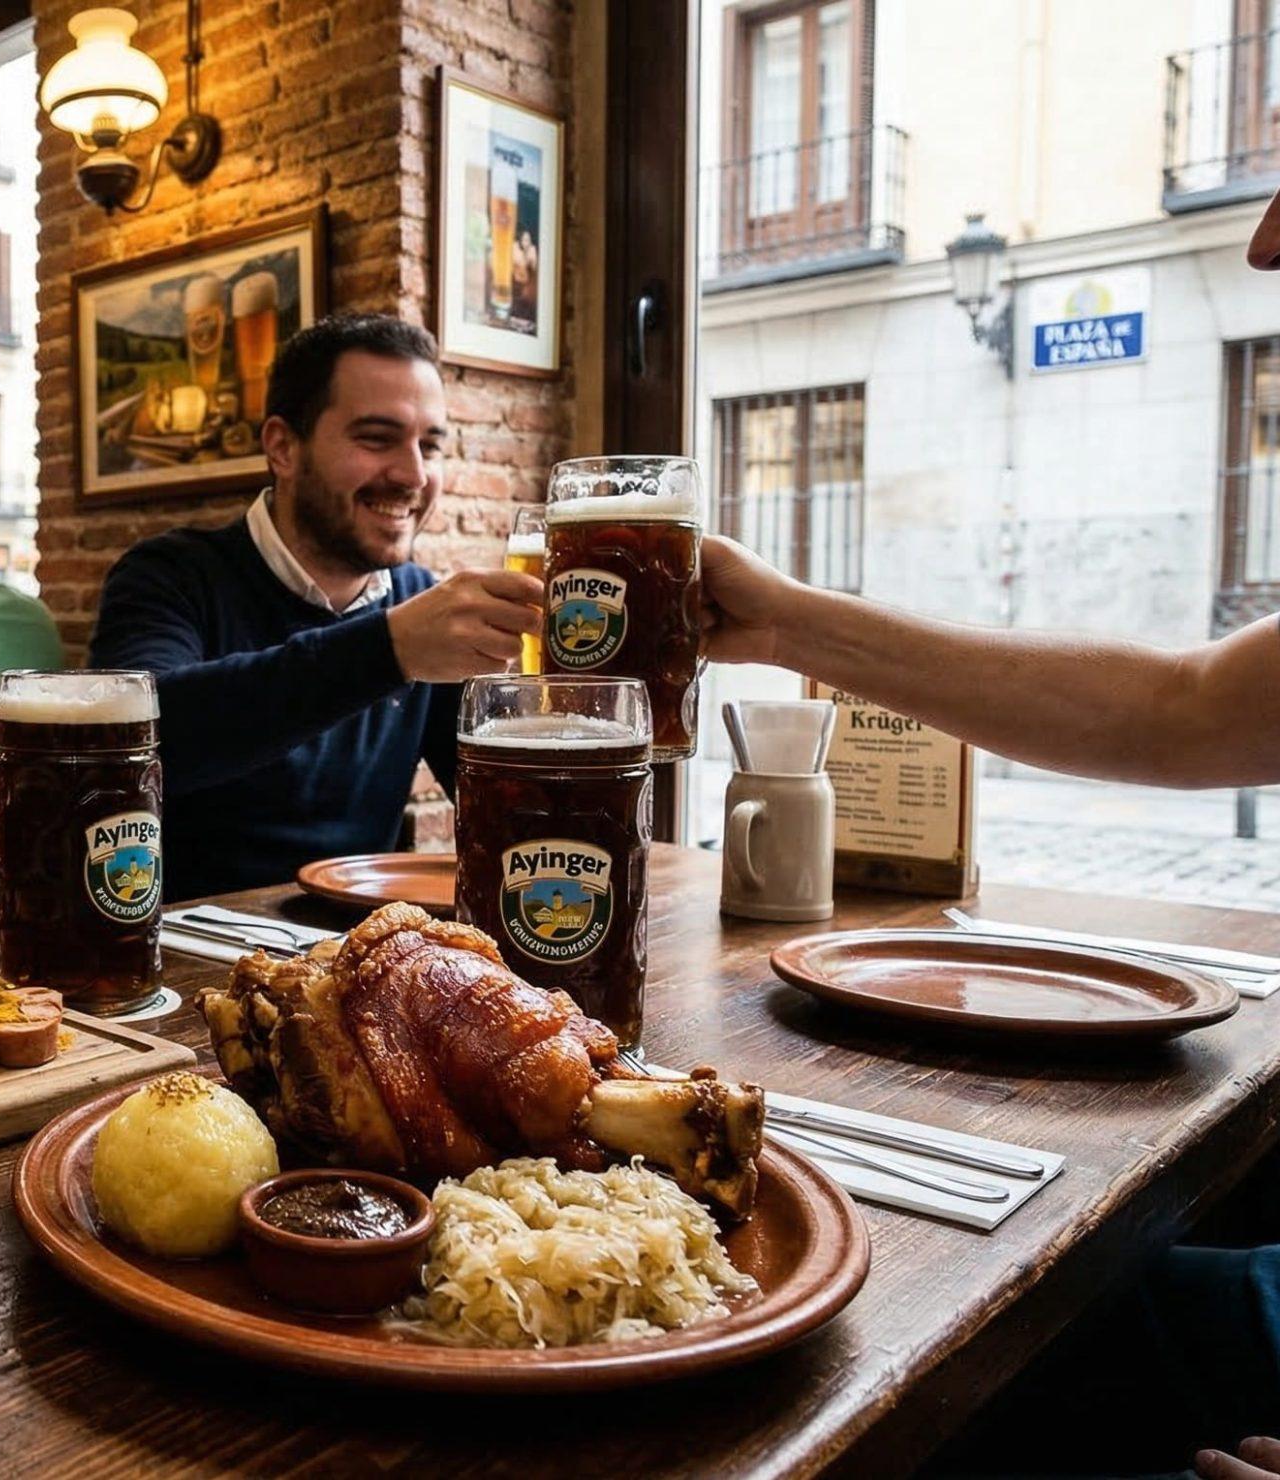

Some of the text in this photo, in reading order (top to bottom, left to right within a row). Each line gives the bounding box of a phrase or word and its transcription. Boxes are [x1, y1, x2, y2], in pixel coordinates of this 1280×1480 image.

[1043, 320, 1109, 346] PLAZA
[552, 573, 622, 601] Ayinger
[509, 846, 607, 877] Ayinger
